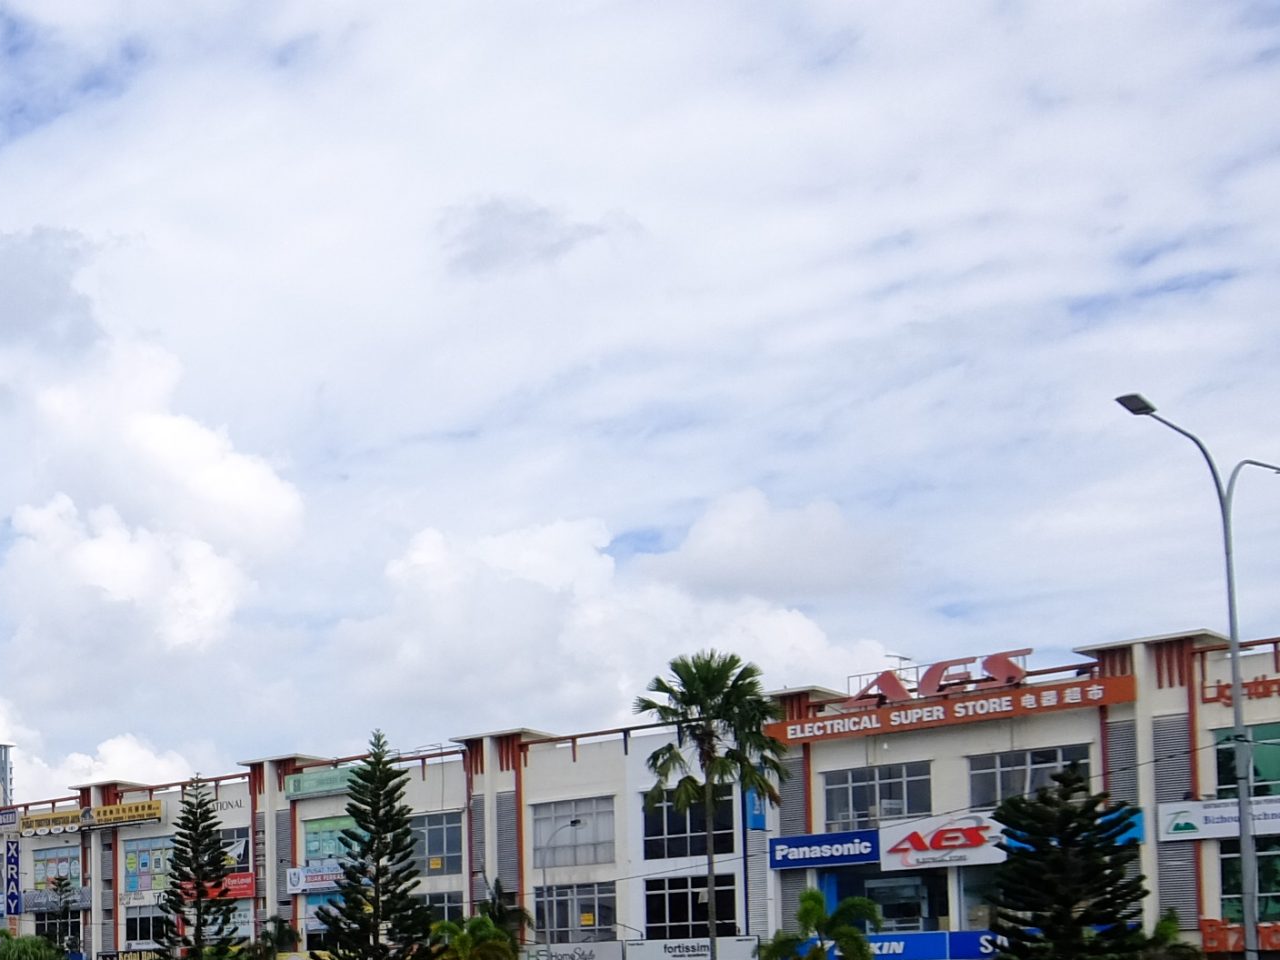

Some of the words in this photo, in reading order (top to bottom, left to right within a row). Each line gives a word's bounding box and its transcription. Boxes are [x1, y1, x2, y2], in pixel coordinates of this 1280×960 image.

[841, 648, 1033, 709] AES
[1021, 684, 1105, 709] 电器超市
[787, 713, 881, 740] ELECTRICAL
[889, 705, 945, 727] SUPER
[954, 696, 1013, 718] STORE
[775, 838, 872, 861] Panasonic
[886, 825, 991, 854] AES
[8, 842, 18, 914] X-RAY
[663, 943, 710, 953] fortissim
